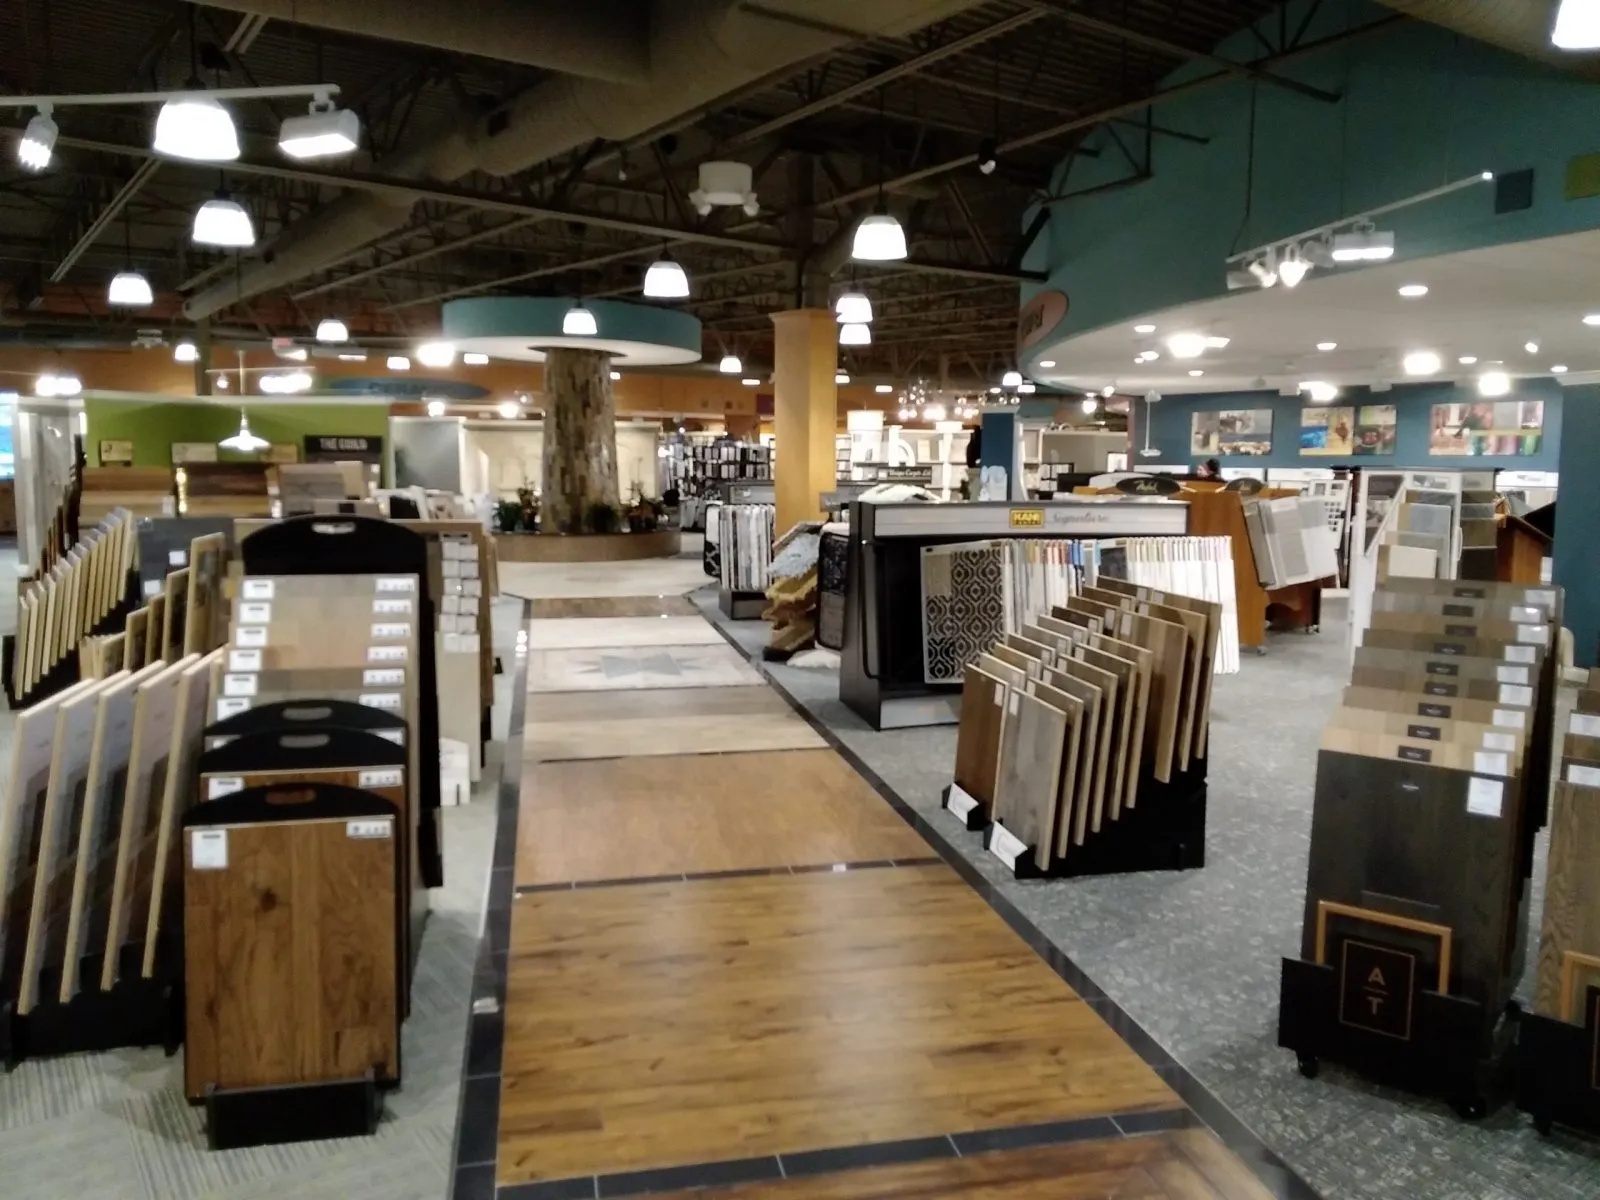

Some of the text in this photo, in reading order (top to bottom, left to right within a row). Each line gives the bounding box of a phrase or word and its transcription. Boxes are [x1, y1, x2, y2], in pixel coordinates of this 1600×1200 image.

[320, 438, 337, 451] THE
[1367, 966, 1386, 986] A
[1366, 995, 1384, 1016] T
